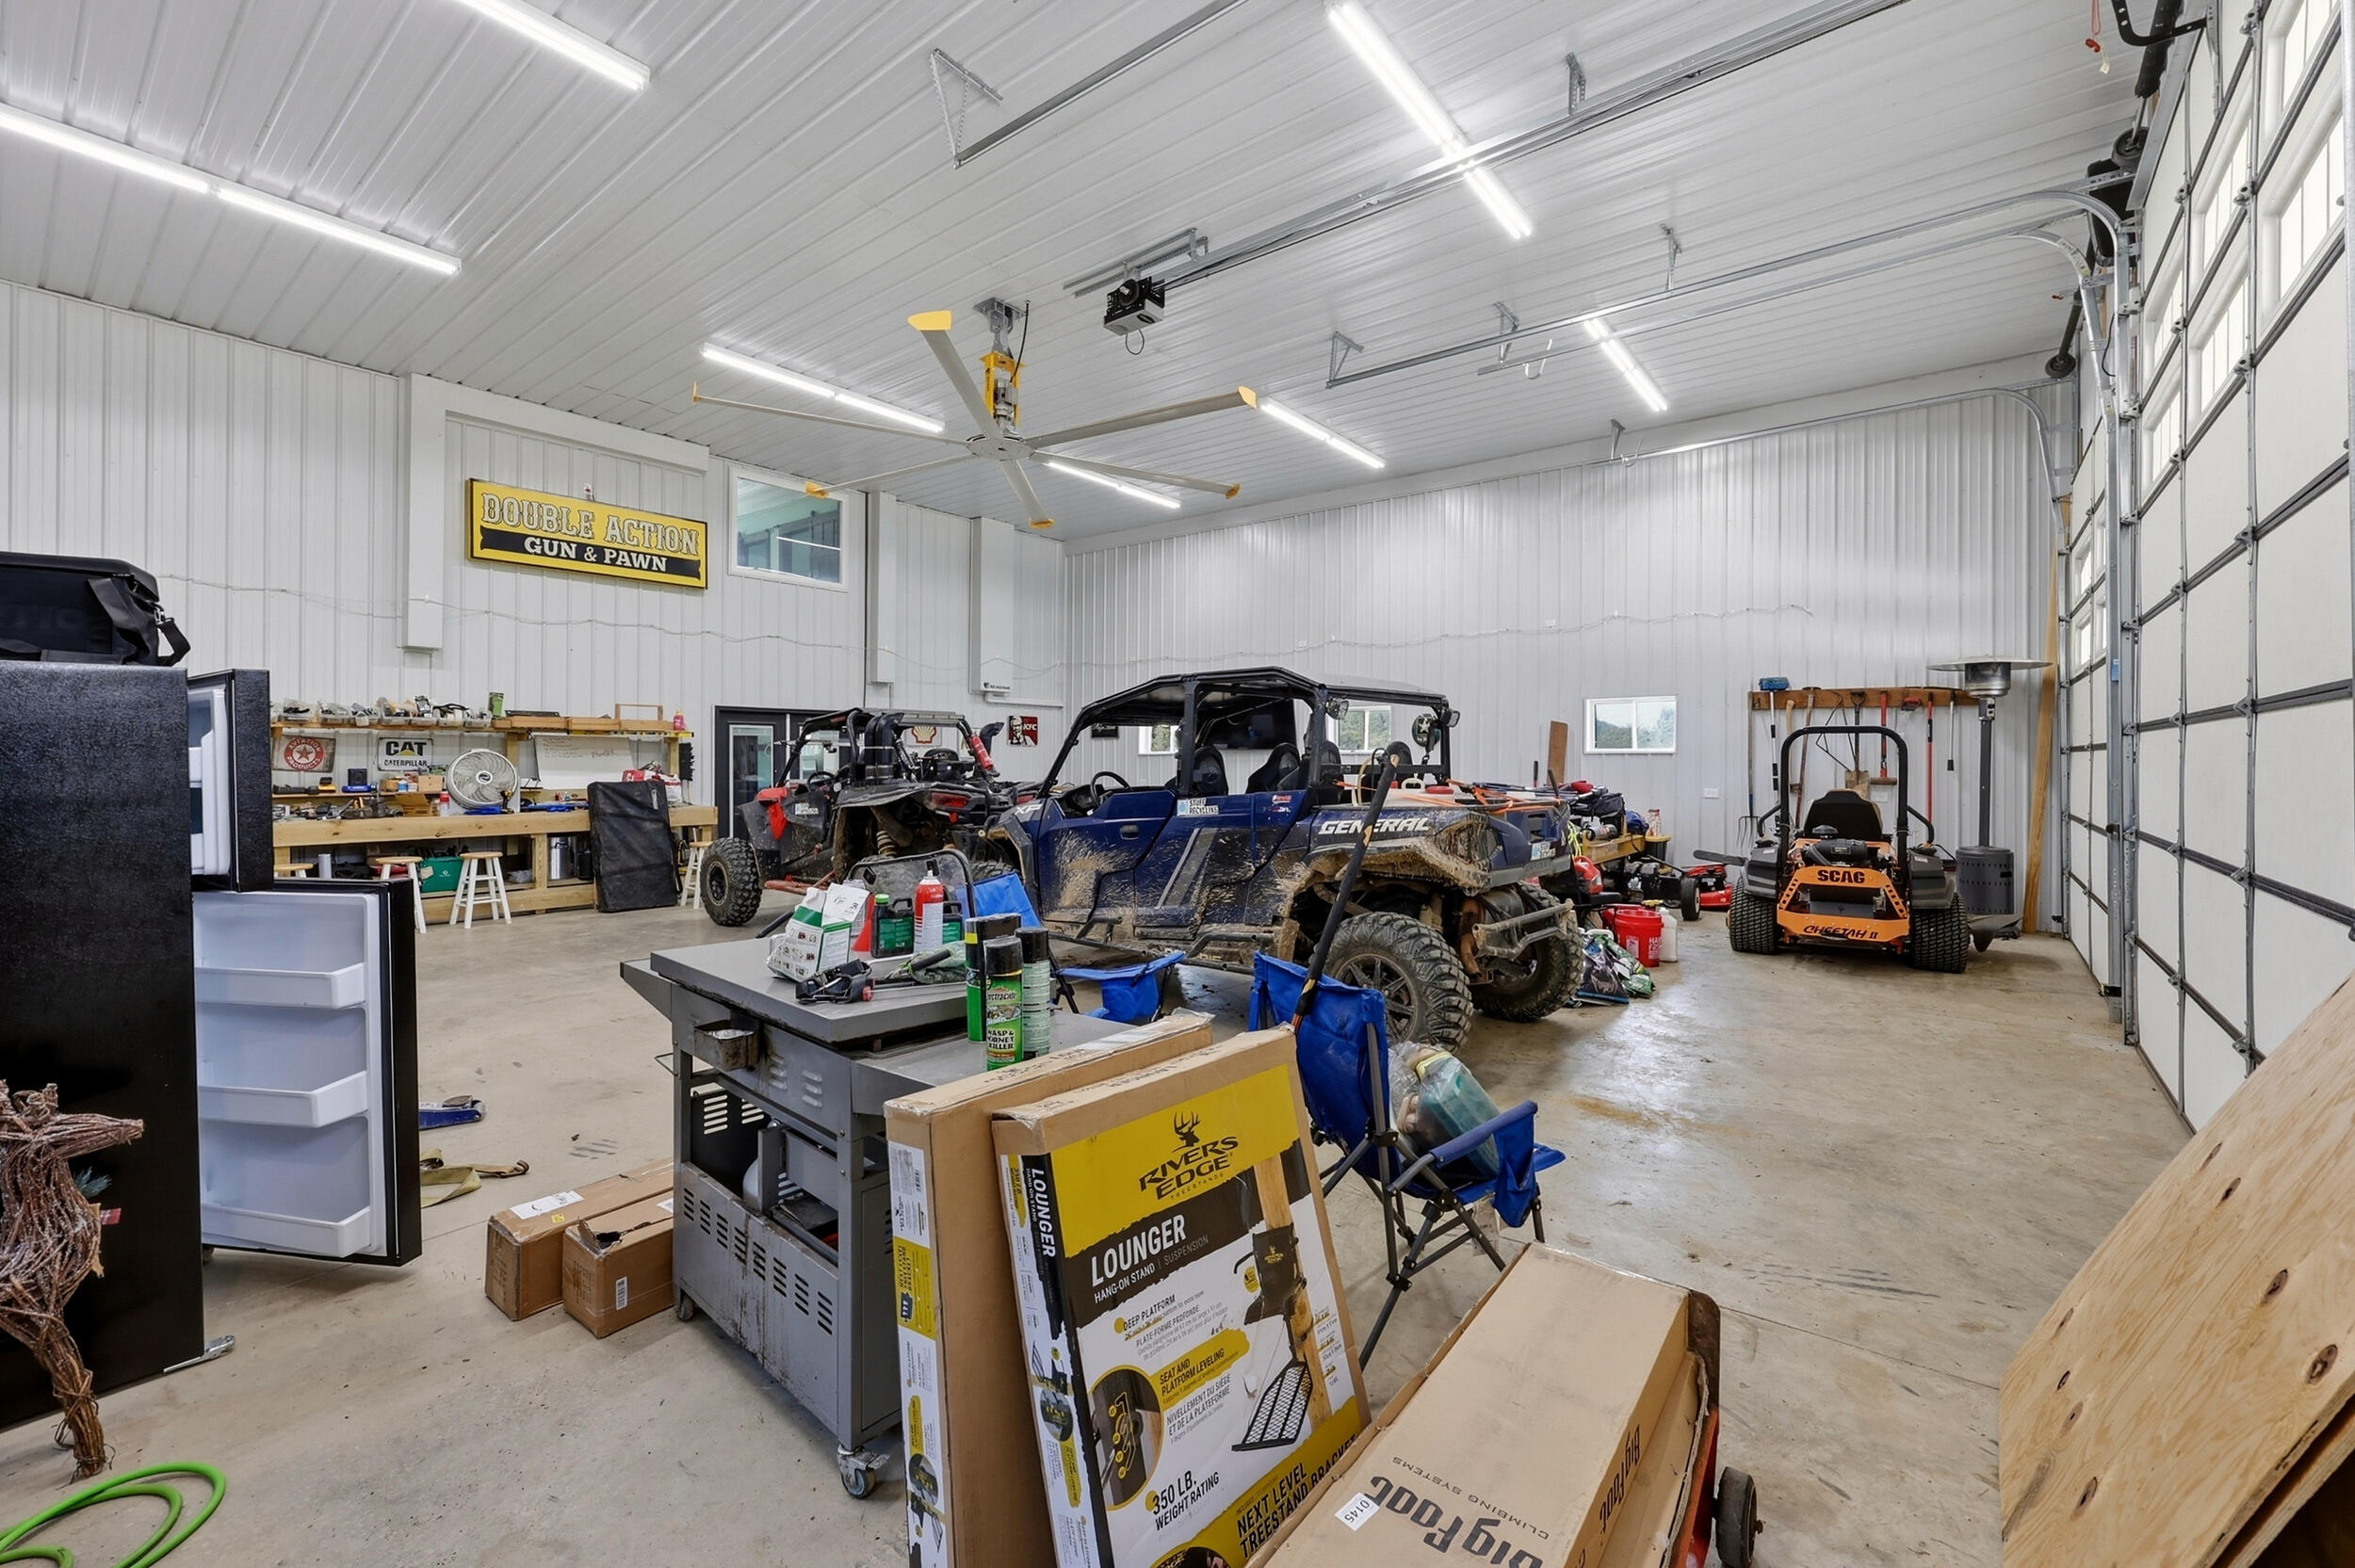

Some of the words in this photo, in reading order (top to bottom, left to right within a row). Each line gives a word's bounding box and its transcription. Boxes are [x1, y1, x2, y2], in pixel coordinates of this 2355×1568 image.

[481, 493, 594, 540] DOUBLE
[605, 515, 699, 556] ACTION
[524, 536, 577, 559] GUN
[583, 546, 597, 562] &
[605, 548, 667, 572] PAWN
[286, 756, 320, 770] PRODUCTS
[288, 737, 321, 751] AVIATION
[385, 741, 427, 756] CAT
[384, 759, 427, 768] CATERPILLAR
[1015, 804, 1043, 815] XP
[1319, 817, 1430, 834] GENERAL
[1817, 869, 1865, 883] SCAG
[1803, 925, 1867, 939] CHEETAH
[1139, 1136, 1239, 1192] RIVERS
[1155, 1155, 1230, 1200] EDGE
[1031, 1169, 1056, 1258] LOUNGER
[1091, 1214, 1187, 1287] LOUNGER
[1094, 1276, 1130, 1304] HANG-ON
[1130, 1262, 1156, 1284] STAND
[1163, 1235, 1210, 1266] SUSPENSION
[1123, 1314, 1140, 1332] DEEP
[1141, 1294, 1176, 1321] PLATFORM
[1161, 1367, 1176, 1384] SEAT
[1177, 1358, 1191, 1371] AND
[1161, 1368, 1195, 1397] PLATFORM
[1196, 1349, 1225, 1374] LEVELING
[1167, 1391, 1207, 1426] NIVELLEMENT
[1168, 1423, 1177, 1436] ET
[1186, 1413, 1194, 1425] LA
[1152, 1484, 1175, 1515] 350
[1178, 1470, 1196, 1496] LB.
[1392, 1456, 1463, 1495] SYSTEMS
[1155, 1496, 1188, 1530] WEIGHT
[1190, 1471, 1220, 1504] RATING
[1237, 1494, 1269, 1538] NEXT
[1272, 1462, 1307, 1505] LEVEL
[1344, 1499, 1371, 1524] 0145
[1468, 1495, 1550, 1541] CLIMBING
[1240, 1482, 1309, 1559] TREESTAND
